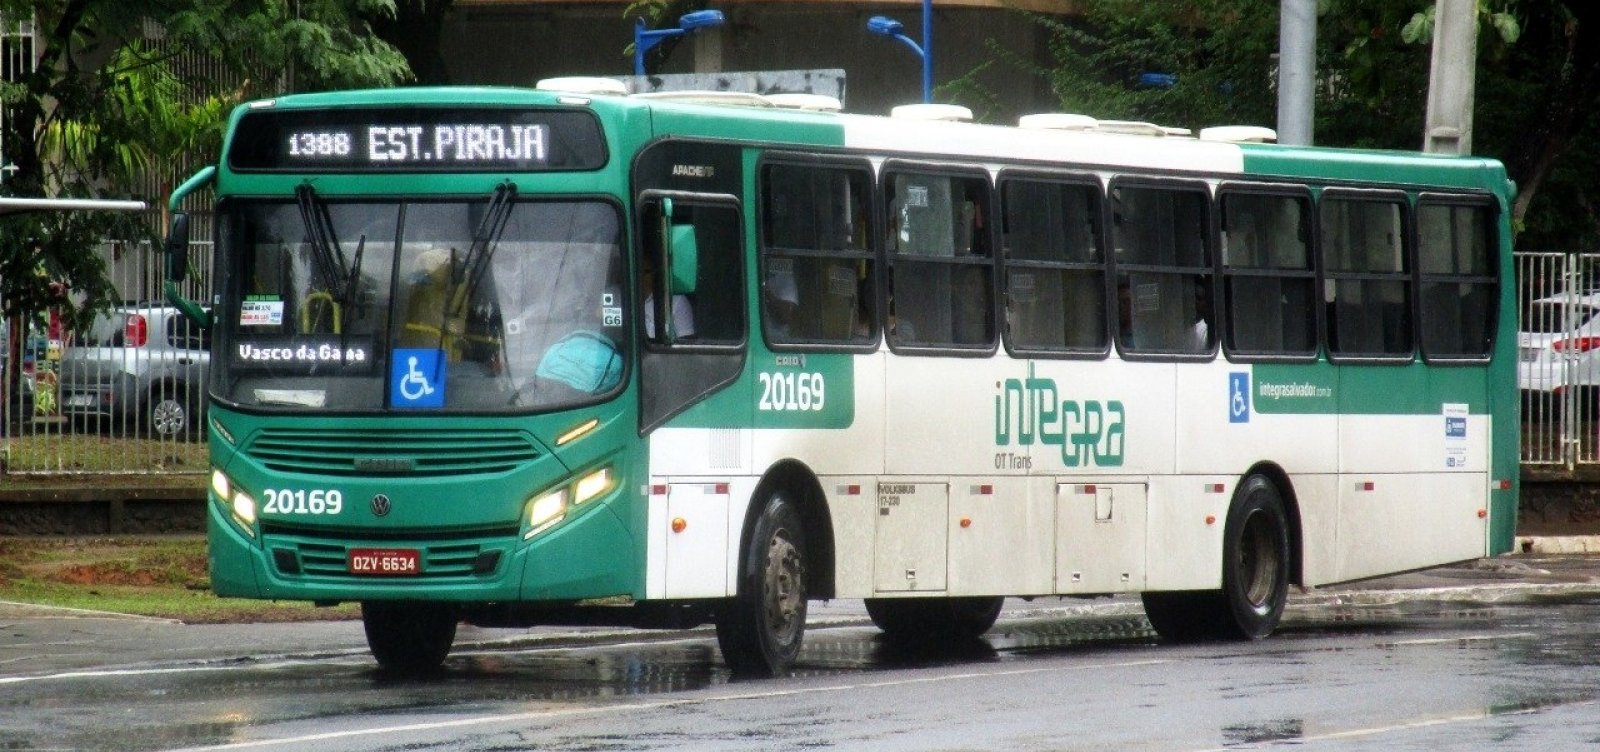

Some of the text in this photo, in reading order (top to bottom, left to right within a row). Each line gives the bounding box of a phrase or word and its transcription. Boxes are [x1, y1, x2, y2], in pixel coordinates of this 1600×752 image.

[288, 132, 350, 156] 1388
[604, 315, 621, 325] G6
[239, 344, 293, 361] Vasco
[295, 344, 316, 361] da
[759, 371, 825, 411] 20169
[994, 453, 1033, 470] OT Trans
[262, 488, 343, 514] 20169
